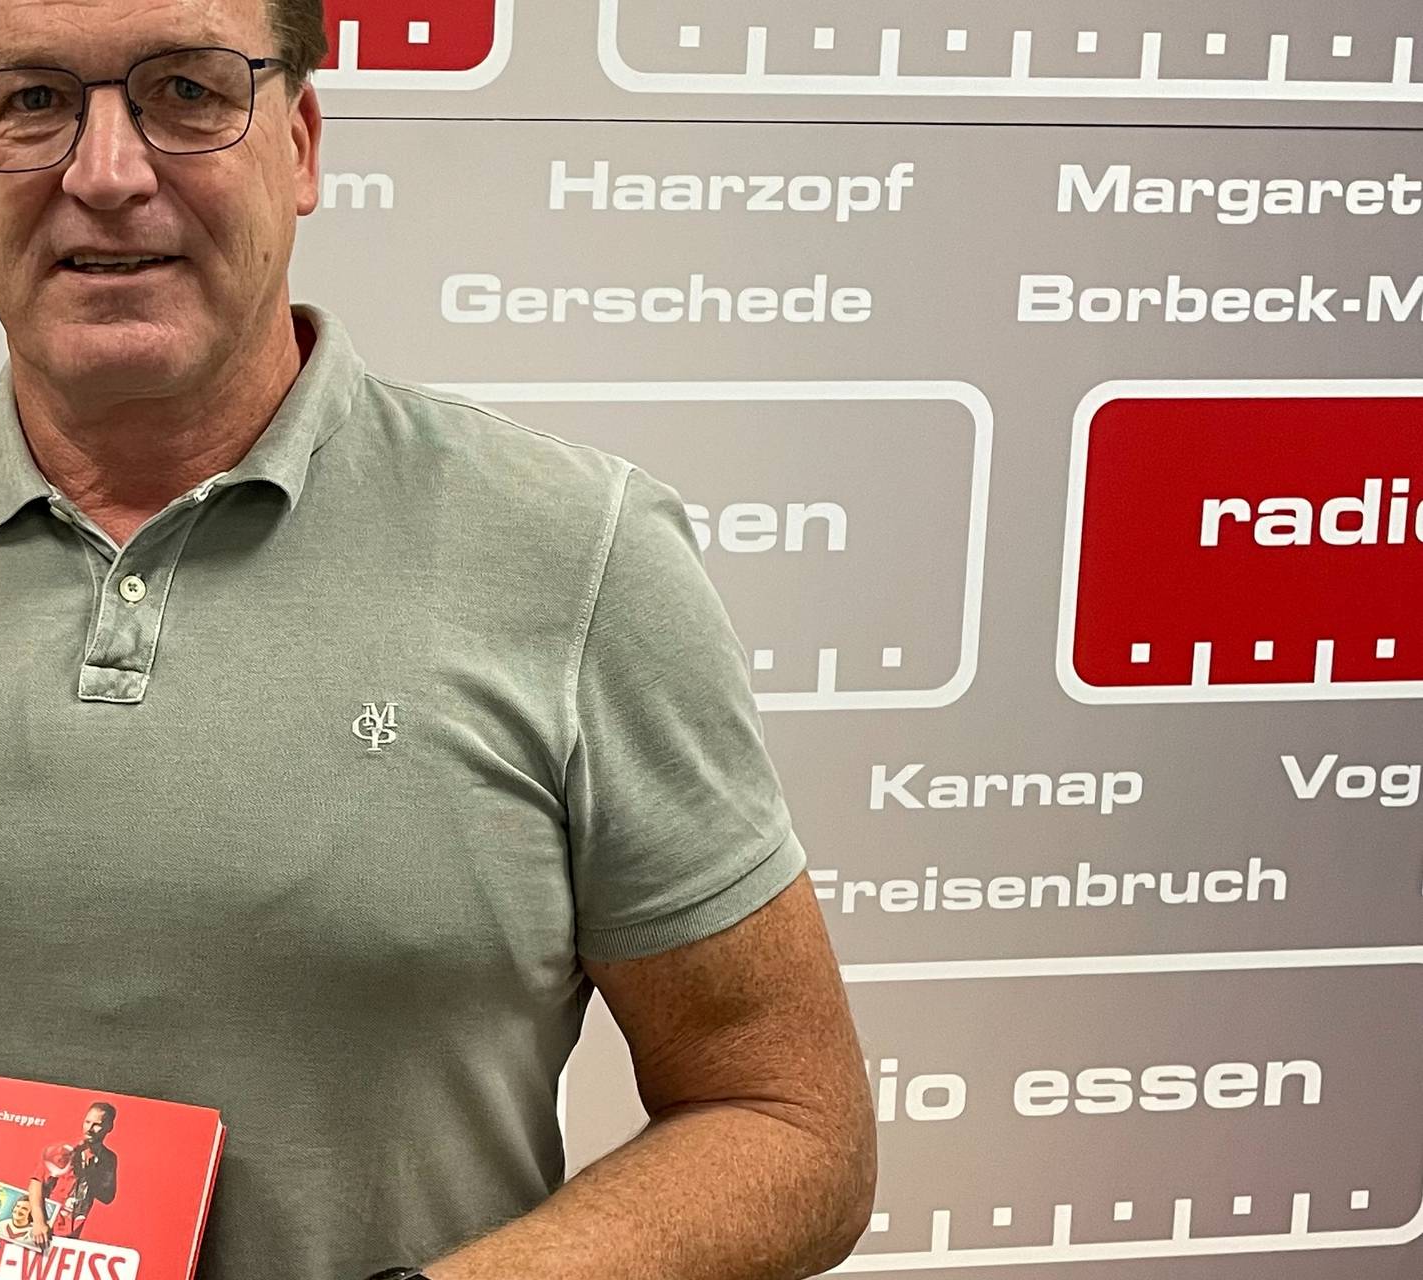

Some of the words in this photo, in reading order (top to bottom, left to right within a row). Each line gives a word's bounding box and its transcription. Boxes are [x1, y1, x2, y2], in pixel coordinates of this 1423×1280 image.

[549, 161, 915, 222] Haarzopf
[1057, 165, 1422, 224] Margaret
[440, 274, 872, 323] Gerschede
[1017, 275, 1423, 322] Borbeck-M
[1200, 478, 1423, 547] radi
[869, 763, 1143, 814] Karnap
[1280, 755, 1422, 807] Vog
[864, 1058, 967, 1122] io
[1013, 1060, 1322, 1117] essen
